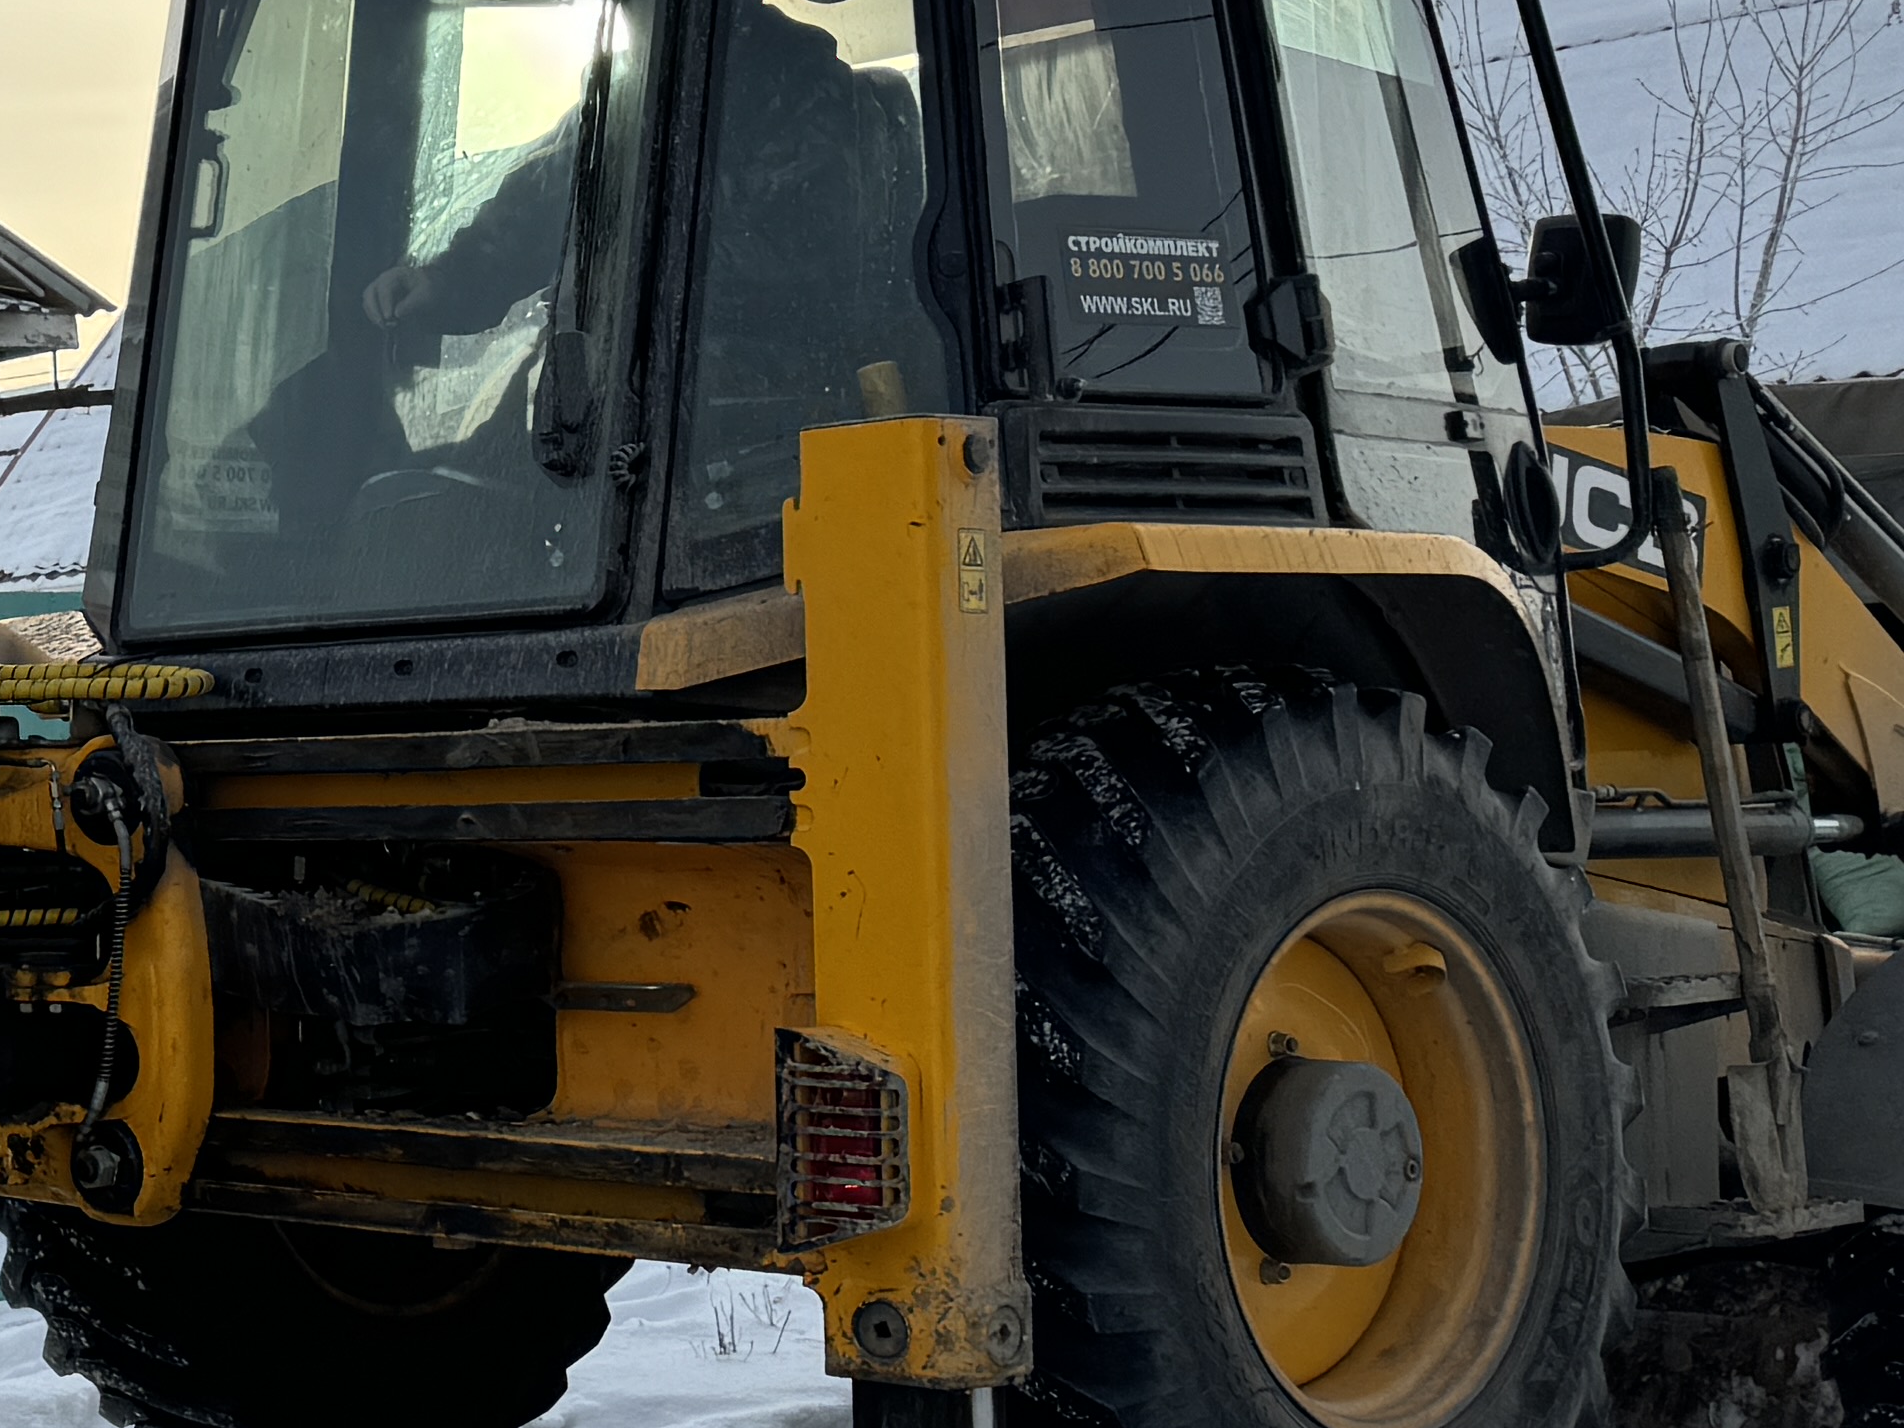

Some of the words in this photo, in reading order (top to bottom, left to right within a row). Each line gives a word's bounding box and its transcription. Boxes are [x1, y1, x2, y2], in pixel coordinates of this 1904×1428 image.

[1067, 233, 1220, 258] СТРОЙКОМПЛЕКТ
[1070, 257, 1083, 277] 8
[1088, 258, 1125, 279] 800
[1129, 260, 1166, 281] 700
[1171, 262, 1184, 281] 5
[1189, 263, 1225, 283] 066
[1080, 295, 1192, 317] WWW.SKL.RU
